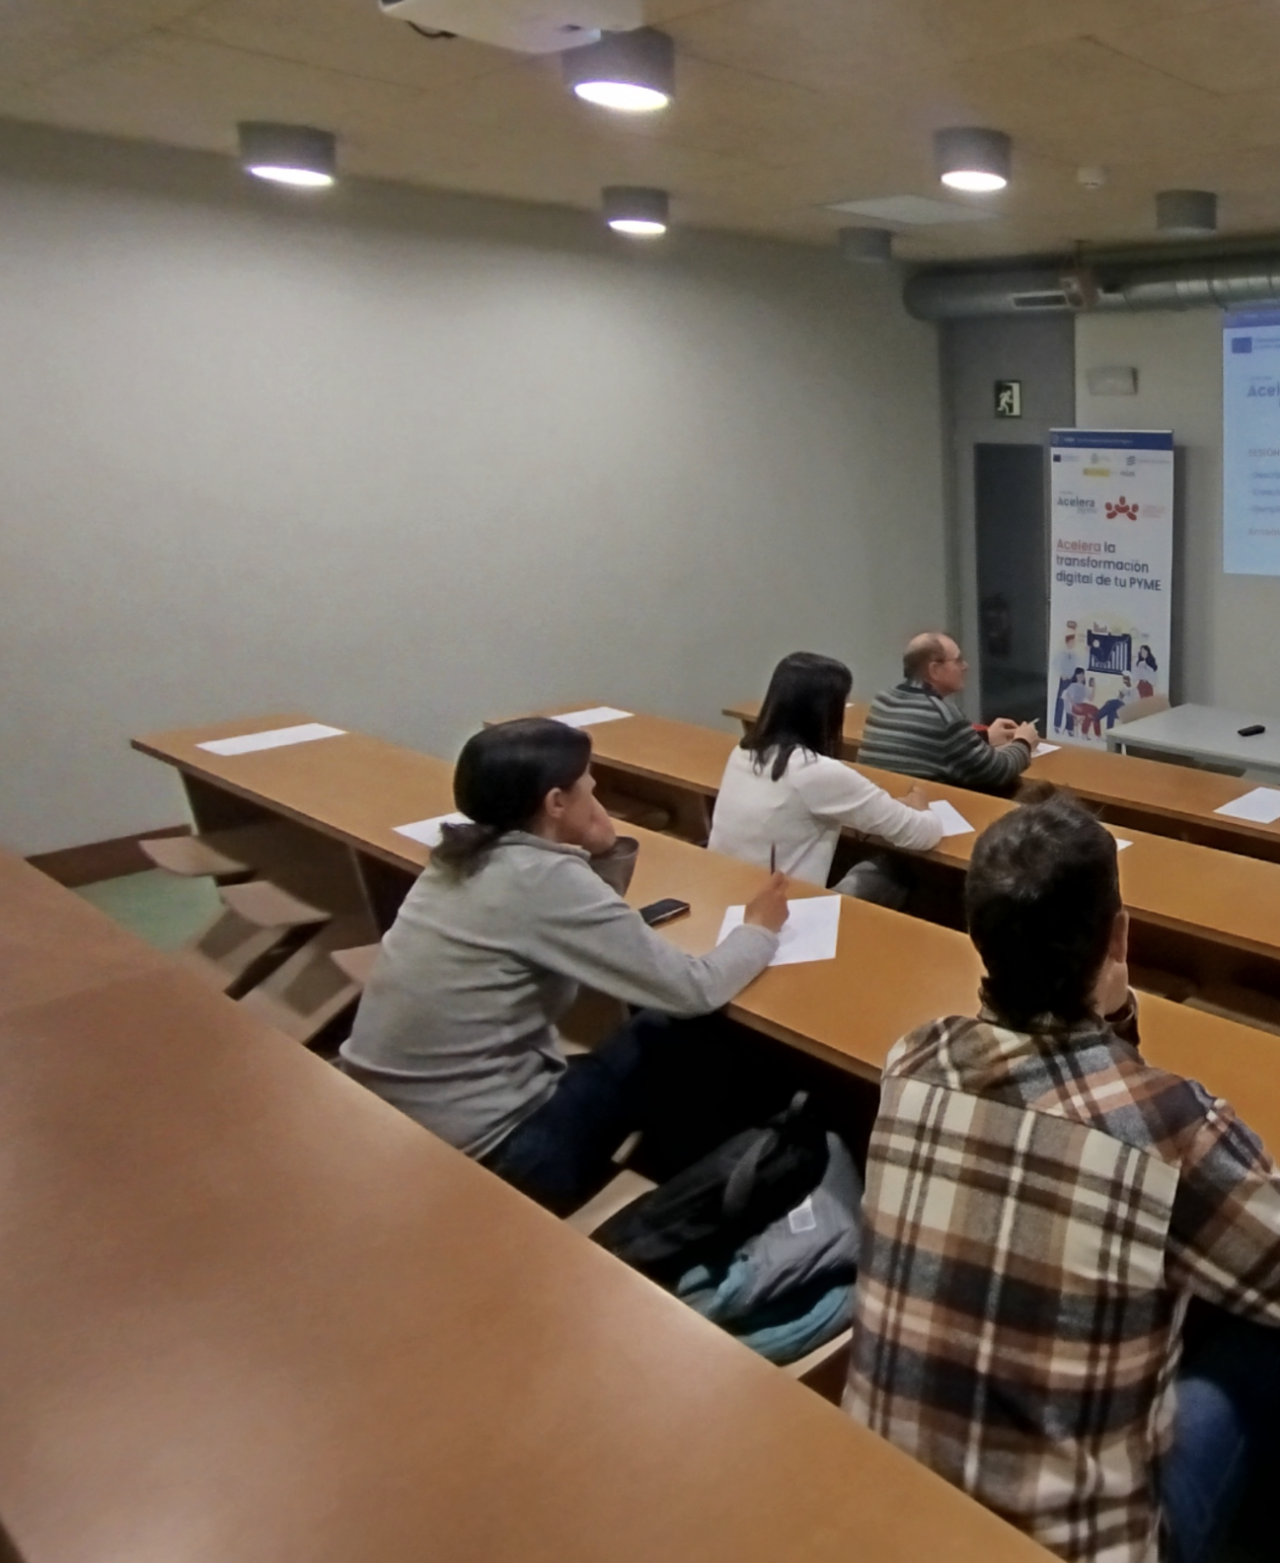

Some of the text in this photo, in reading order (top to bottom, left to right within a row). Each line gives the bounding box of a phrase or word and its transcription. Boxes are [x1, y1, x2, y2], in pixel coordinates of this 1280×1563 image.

[1057, 496, 1096, 508] Acelera
[1057, 539, 1116, 553] Acelera la
[1056, 555, 1149, 573] transformación
[1056, 570, 1162, 591] digital de tu PYME
